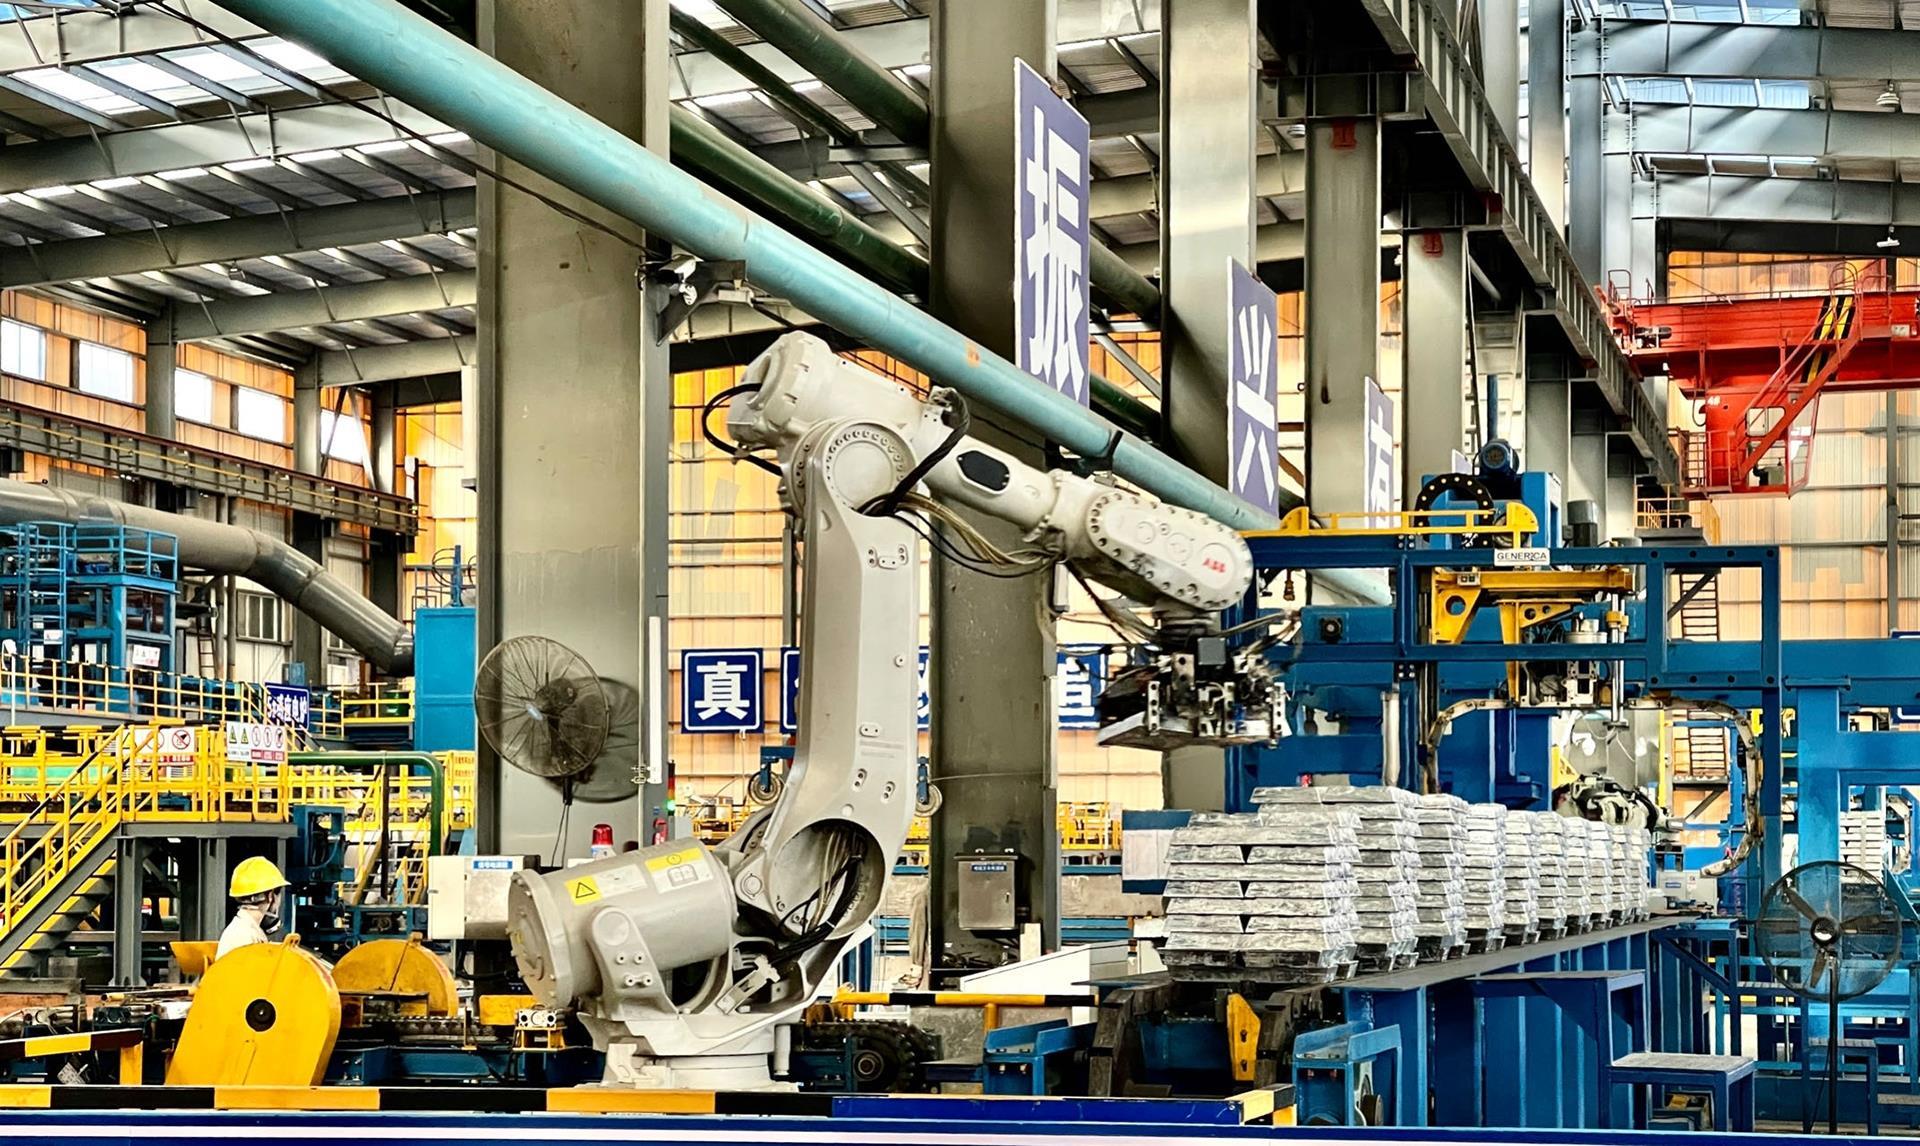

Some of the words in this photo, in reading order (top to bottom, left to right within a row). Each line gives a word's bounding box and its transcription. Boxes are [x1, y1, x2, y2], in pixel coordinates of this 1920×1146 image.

[1026, 105, 1085, 402] 振
[1237, 304, 1276, 506] 兴
[1202, 557, 1227, 574] ABB
[694, 661, 751, 720] 真
